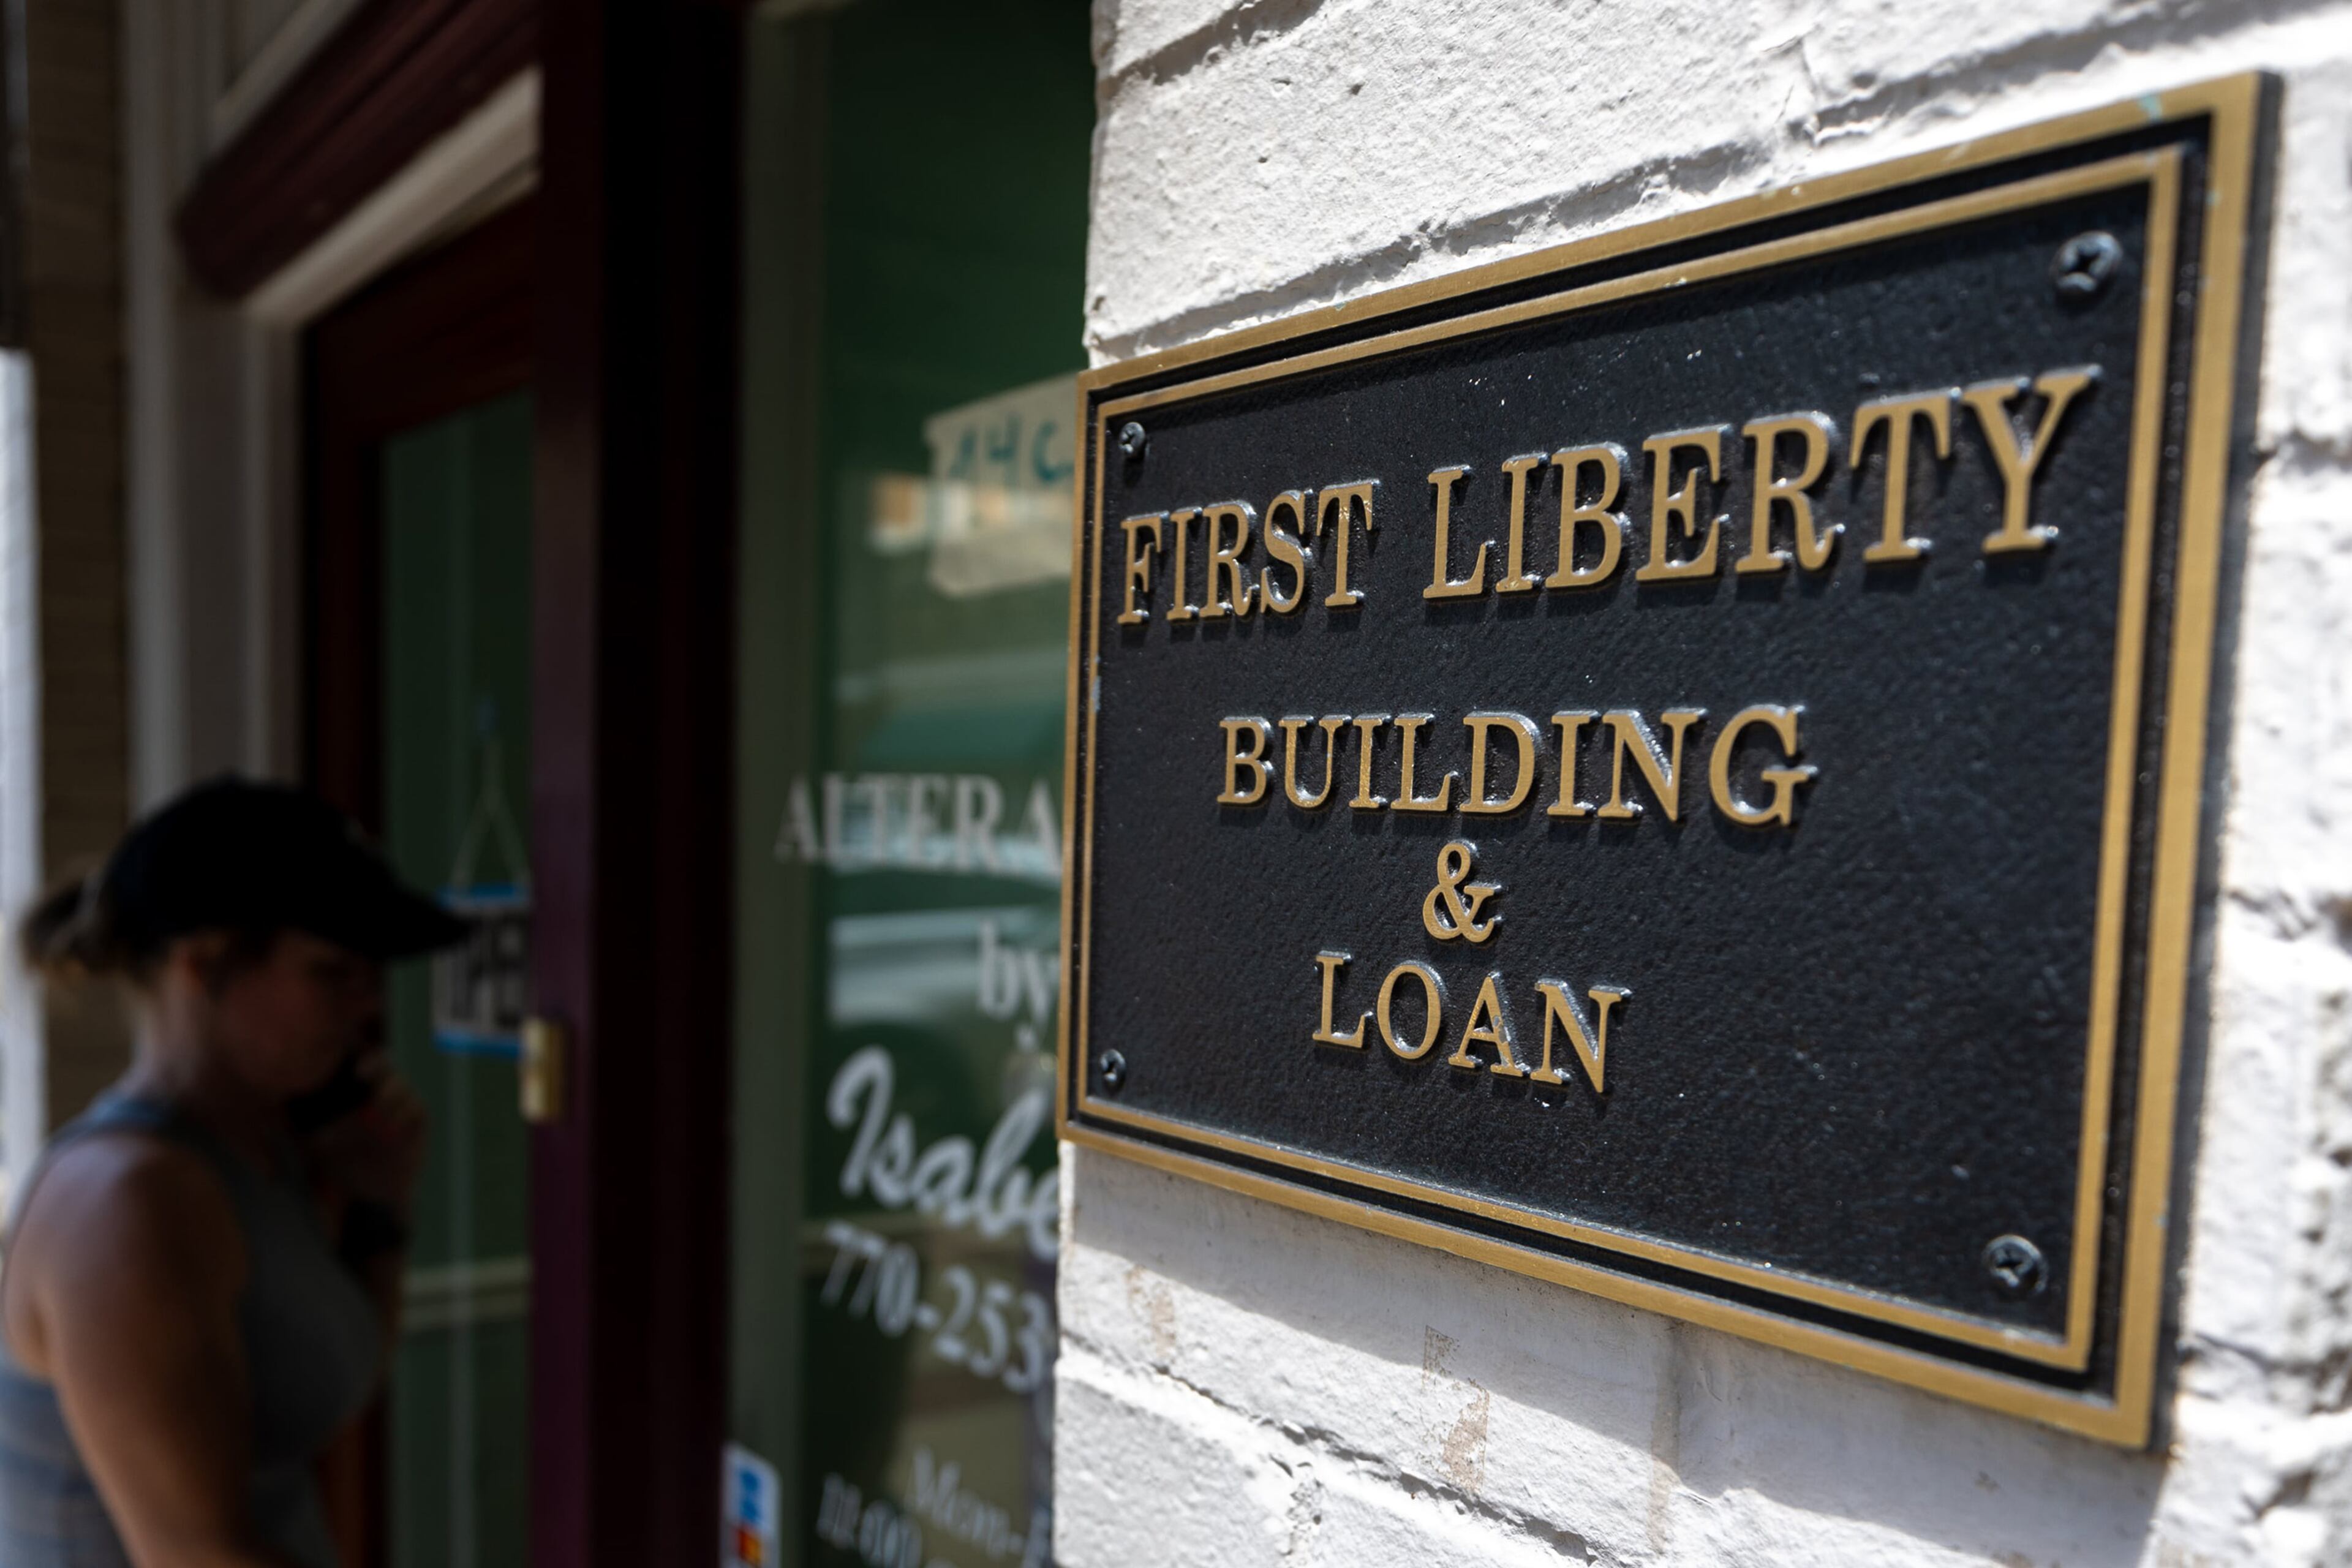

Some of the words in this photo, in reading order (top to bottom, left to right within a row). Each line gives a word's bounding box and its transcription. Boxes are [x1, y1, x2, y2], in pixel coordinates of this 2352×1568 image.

[1116, 480, 1378, 625] FIRST
[1422, 368, 2098, 599] LIBERTY
[773, 773, 1063, 876] ALTERA
[1215, 704, 1818, 827] BUILDING
[1421, 839, 1502, 944] &
[979, 920, 1060, 1050] by
[1311, 951, 1632, 1094] LOAN
